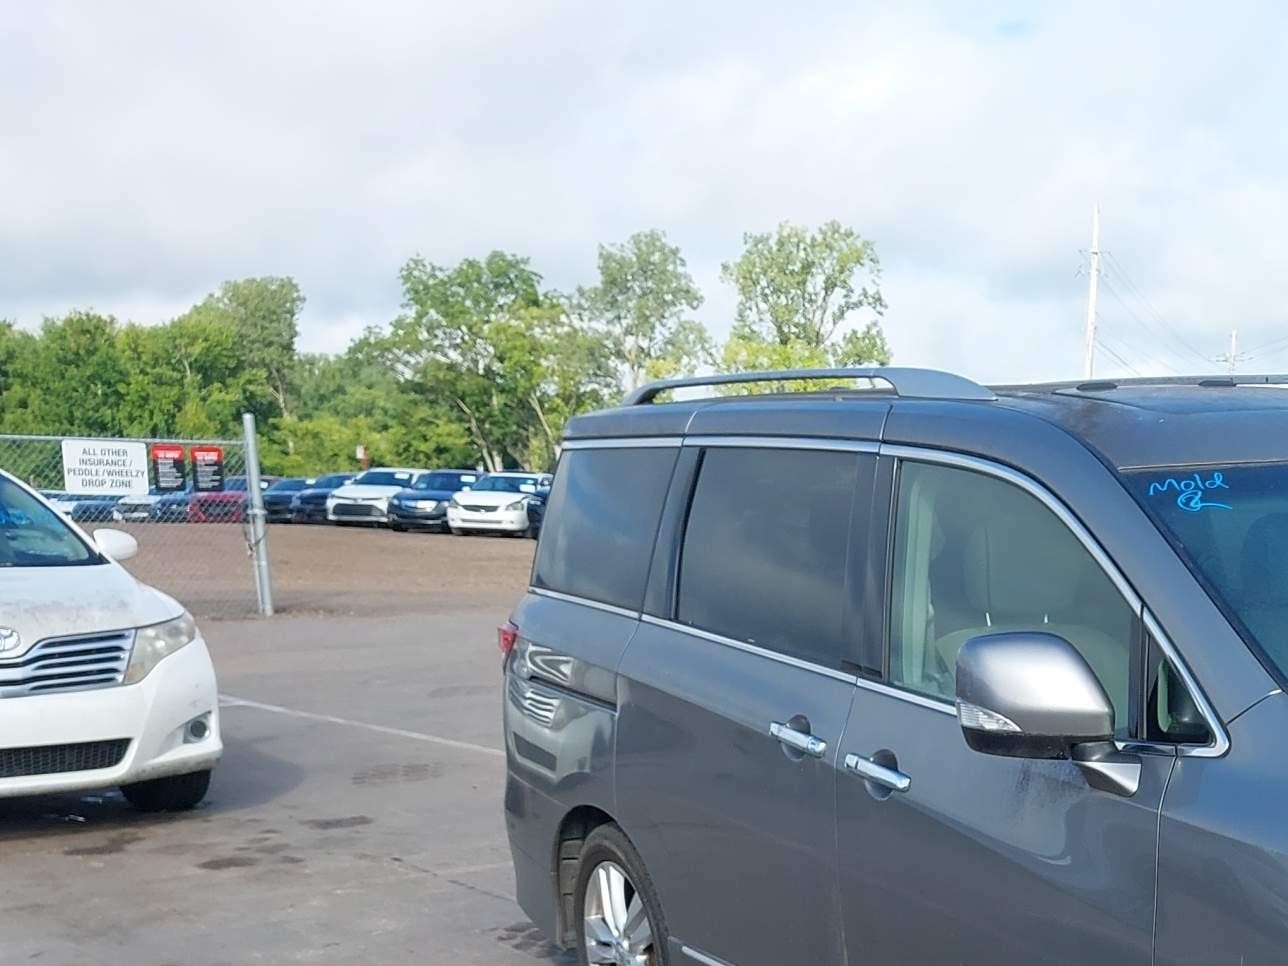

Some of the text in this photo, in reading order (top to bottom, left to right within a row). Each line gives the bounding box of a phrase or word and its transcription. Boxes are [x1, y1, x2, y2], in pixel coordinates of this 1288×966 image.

[82, 448, 128, 457] ALL OTHER
[81, 479, 132, 489] DROP ZONE
